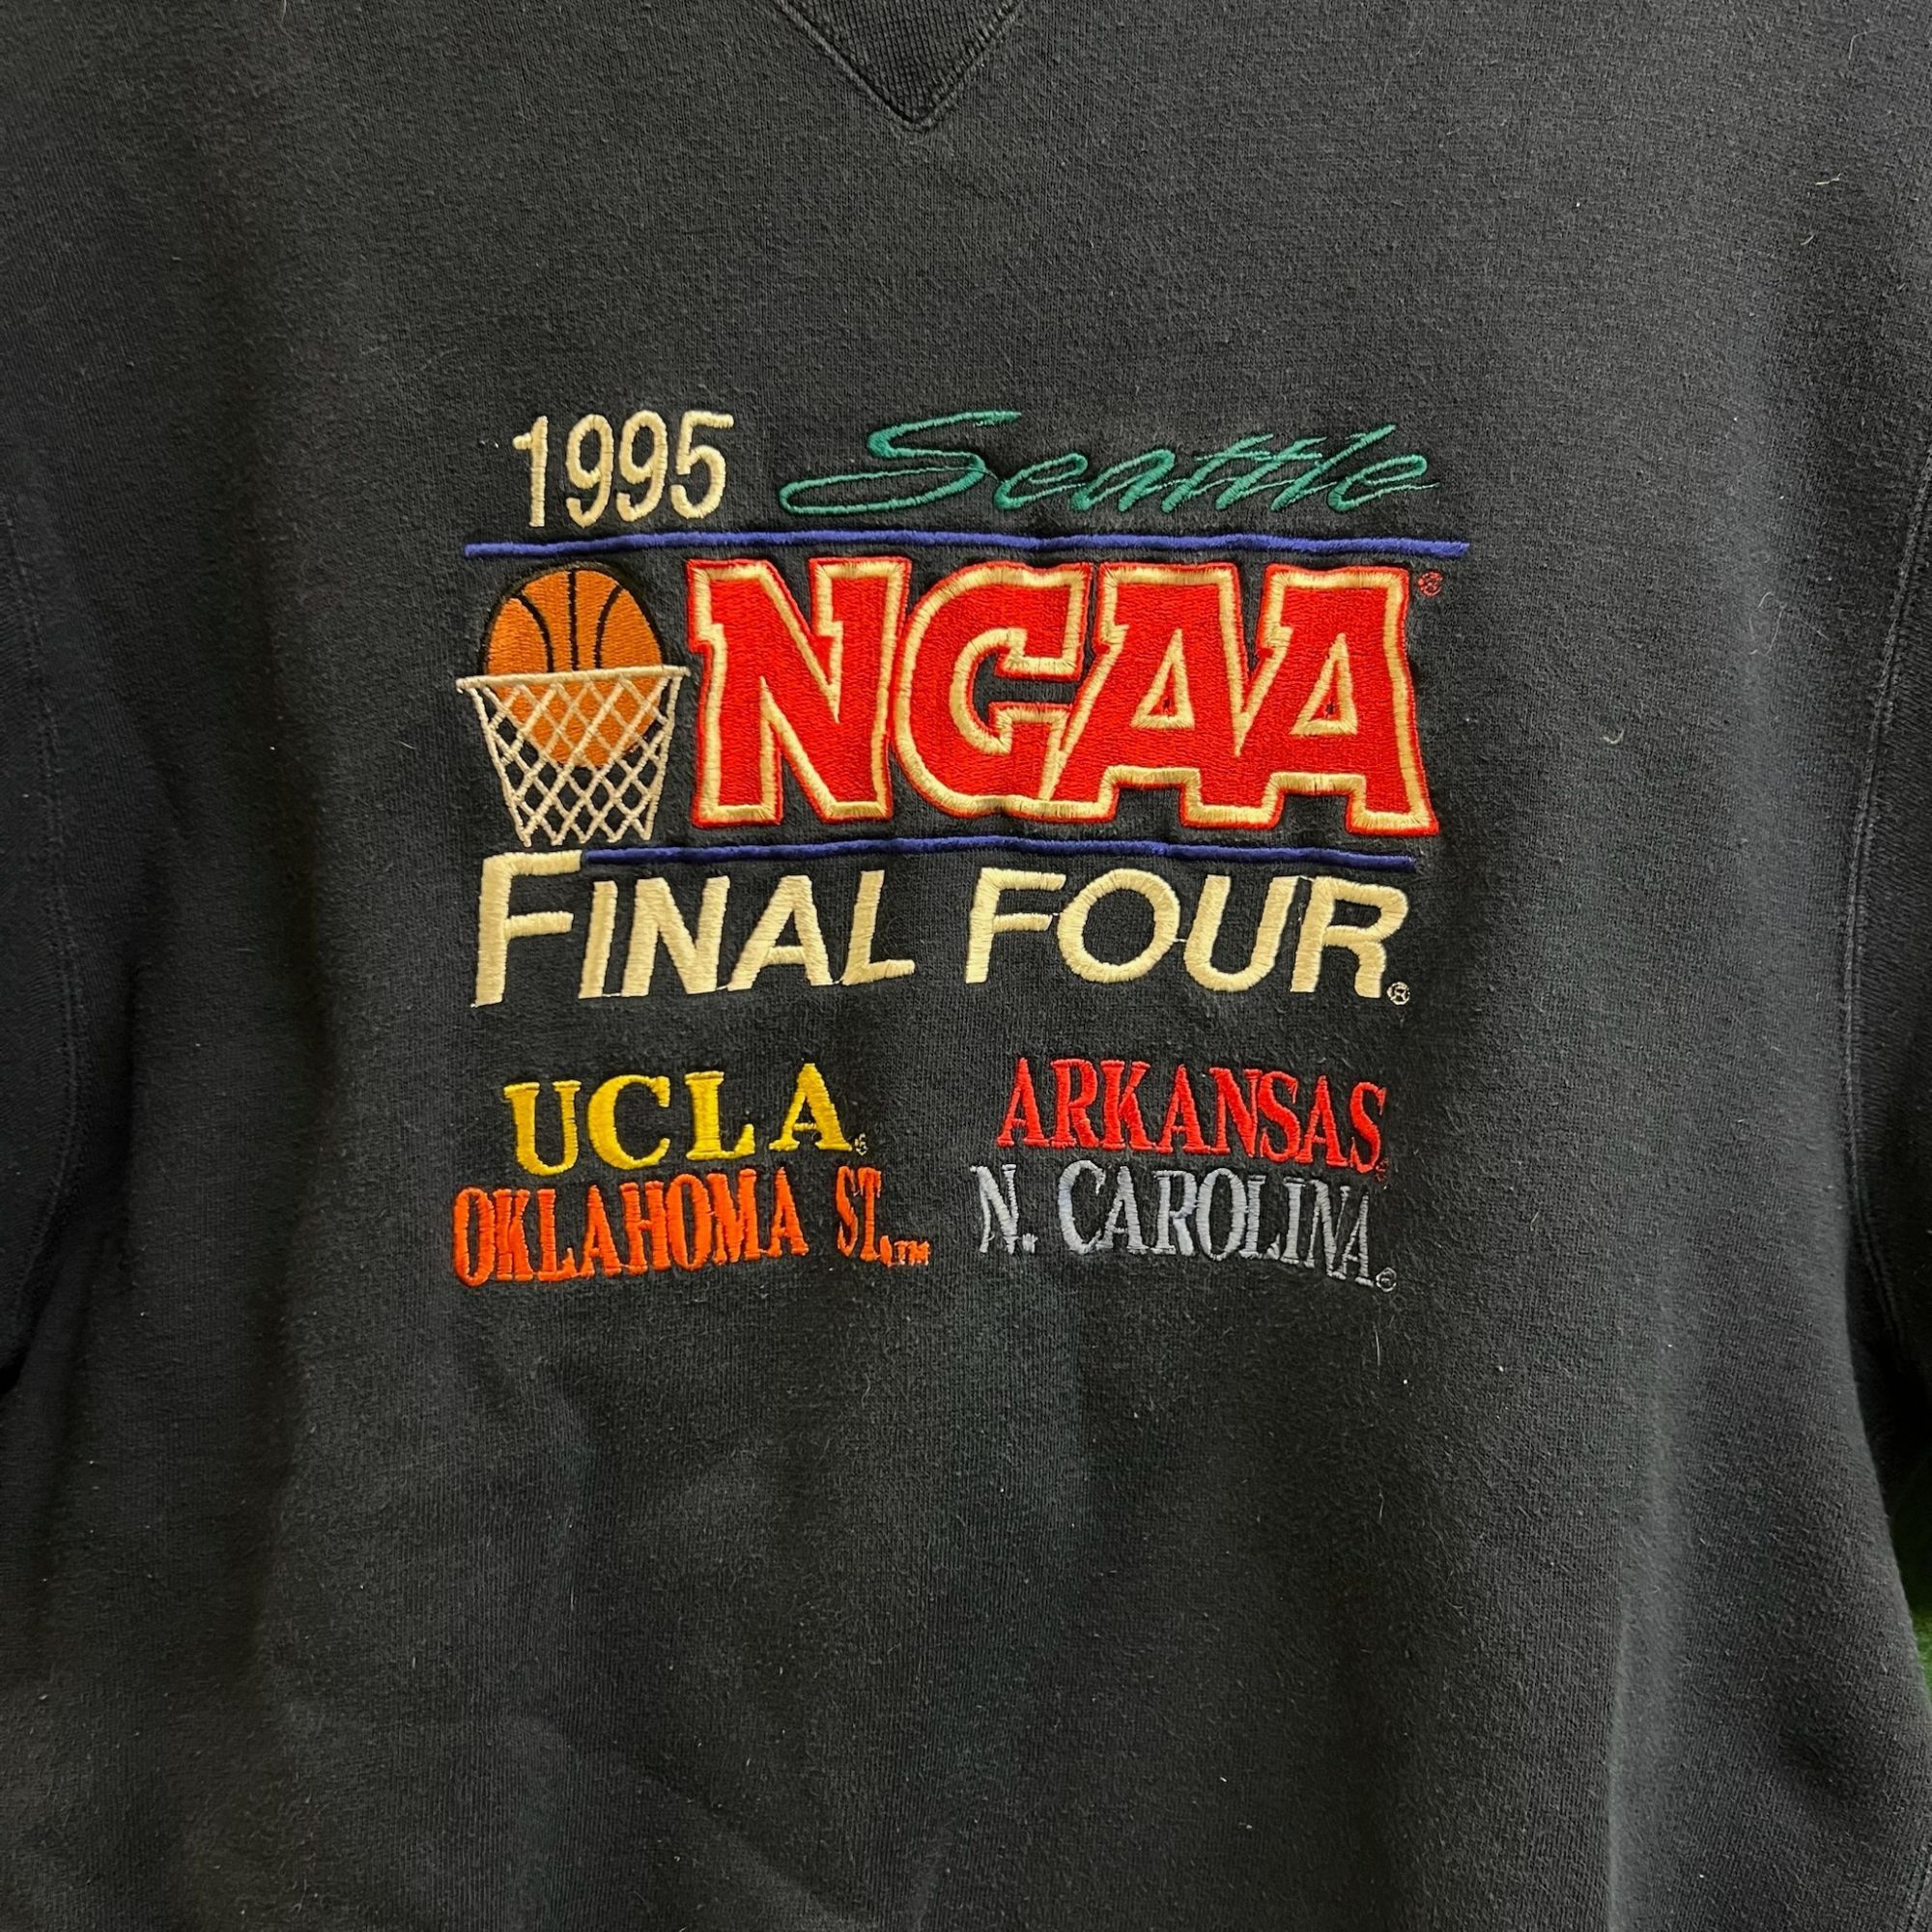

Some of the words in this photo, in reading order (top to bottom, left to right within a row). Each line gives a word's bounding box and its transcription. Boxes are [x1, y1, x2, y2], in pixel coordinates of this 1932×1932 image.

[513, 411, 734, 527] 1995
[780, 410, 1440, 513] Seattle
[687, 557, 1439, 837] NCAA
[470, 849, 915, 1008] FINAL
[965, 867, 1409, 999] FOUR
[503, 1063, 852, 1177] UCLA
[996, 1057, 1386, 1173] ARKANSAS
[452, 1166, 809, 1287] OKLAHOMA
[970, 1162, 1038, 1255] N.
[1058, 1160, 1375, 1288] CAROLINA
